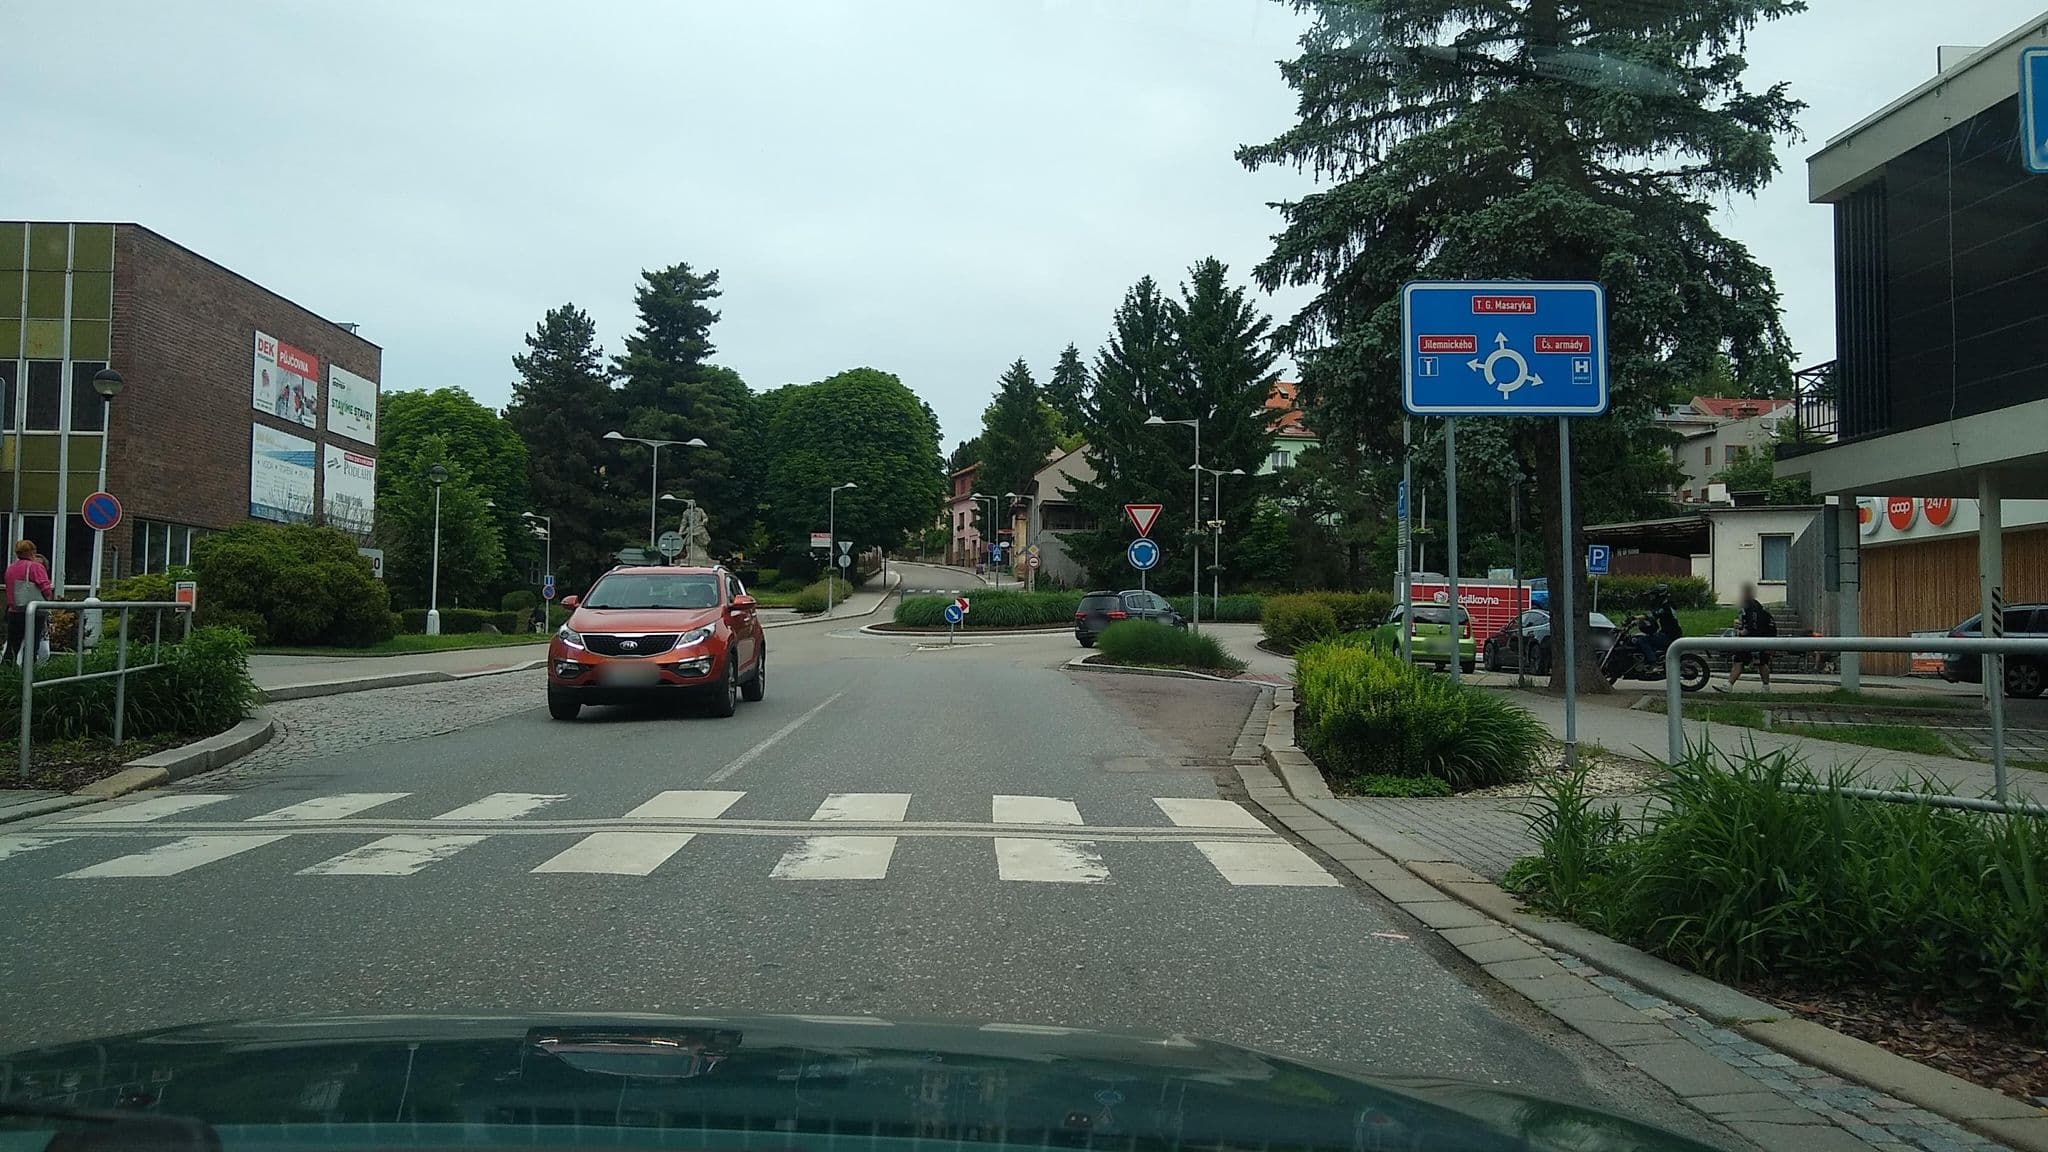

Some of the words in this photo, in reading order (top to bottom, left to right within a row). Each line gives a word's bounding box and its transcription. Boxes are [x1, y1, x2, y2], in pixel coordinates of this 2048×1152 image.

[1477, 301, 1483, 310] T.
[1485, 301, 1493, 310] G.
[1495, 301, 1531, 312] Masaryka
[258, 338, 275, 357] DEK
[1424, 339, 1473, 349] Jilemnického
[1542, 338, 1553, 349] Čs.
[1555, 339, 1583, 351] armády
[279, 350, 309, 374] PŮJČOVNA
[1891, 501, 1910, 514] coop
[1593, 549, 1604, 566] P
[1457, 594, 1500, 606] ásilkovna
